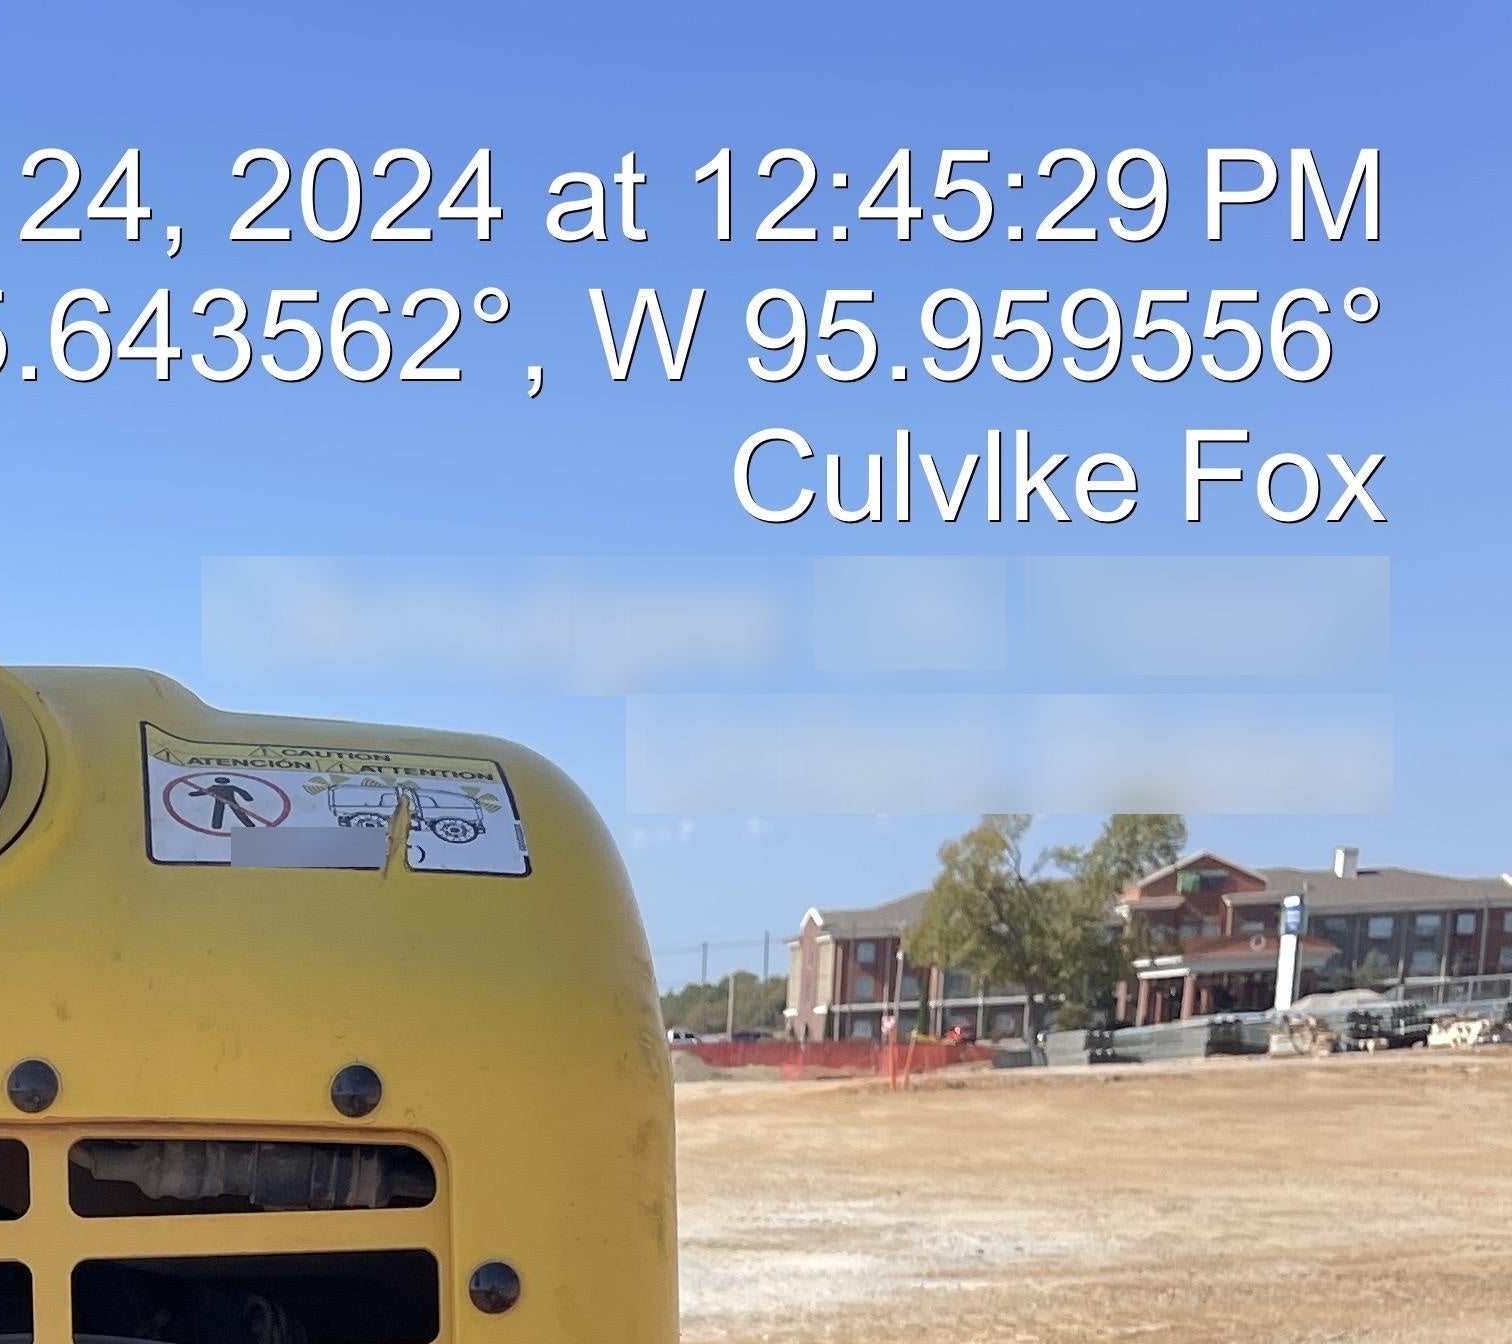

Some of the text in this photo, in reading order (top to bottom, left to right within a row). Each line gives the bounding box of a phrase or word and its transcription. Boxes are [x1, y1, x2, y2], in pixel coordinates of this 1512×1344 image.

[281, 748, 391, 762] CAUTION
[187, 756, 312, 770] ATENCIÓN
[360, 765, 494, 781] ATTENTION
